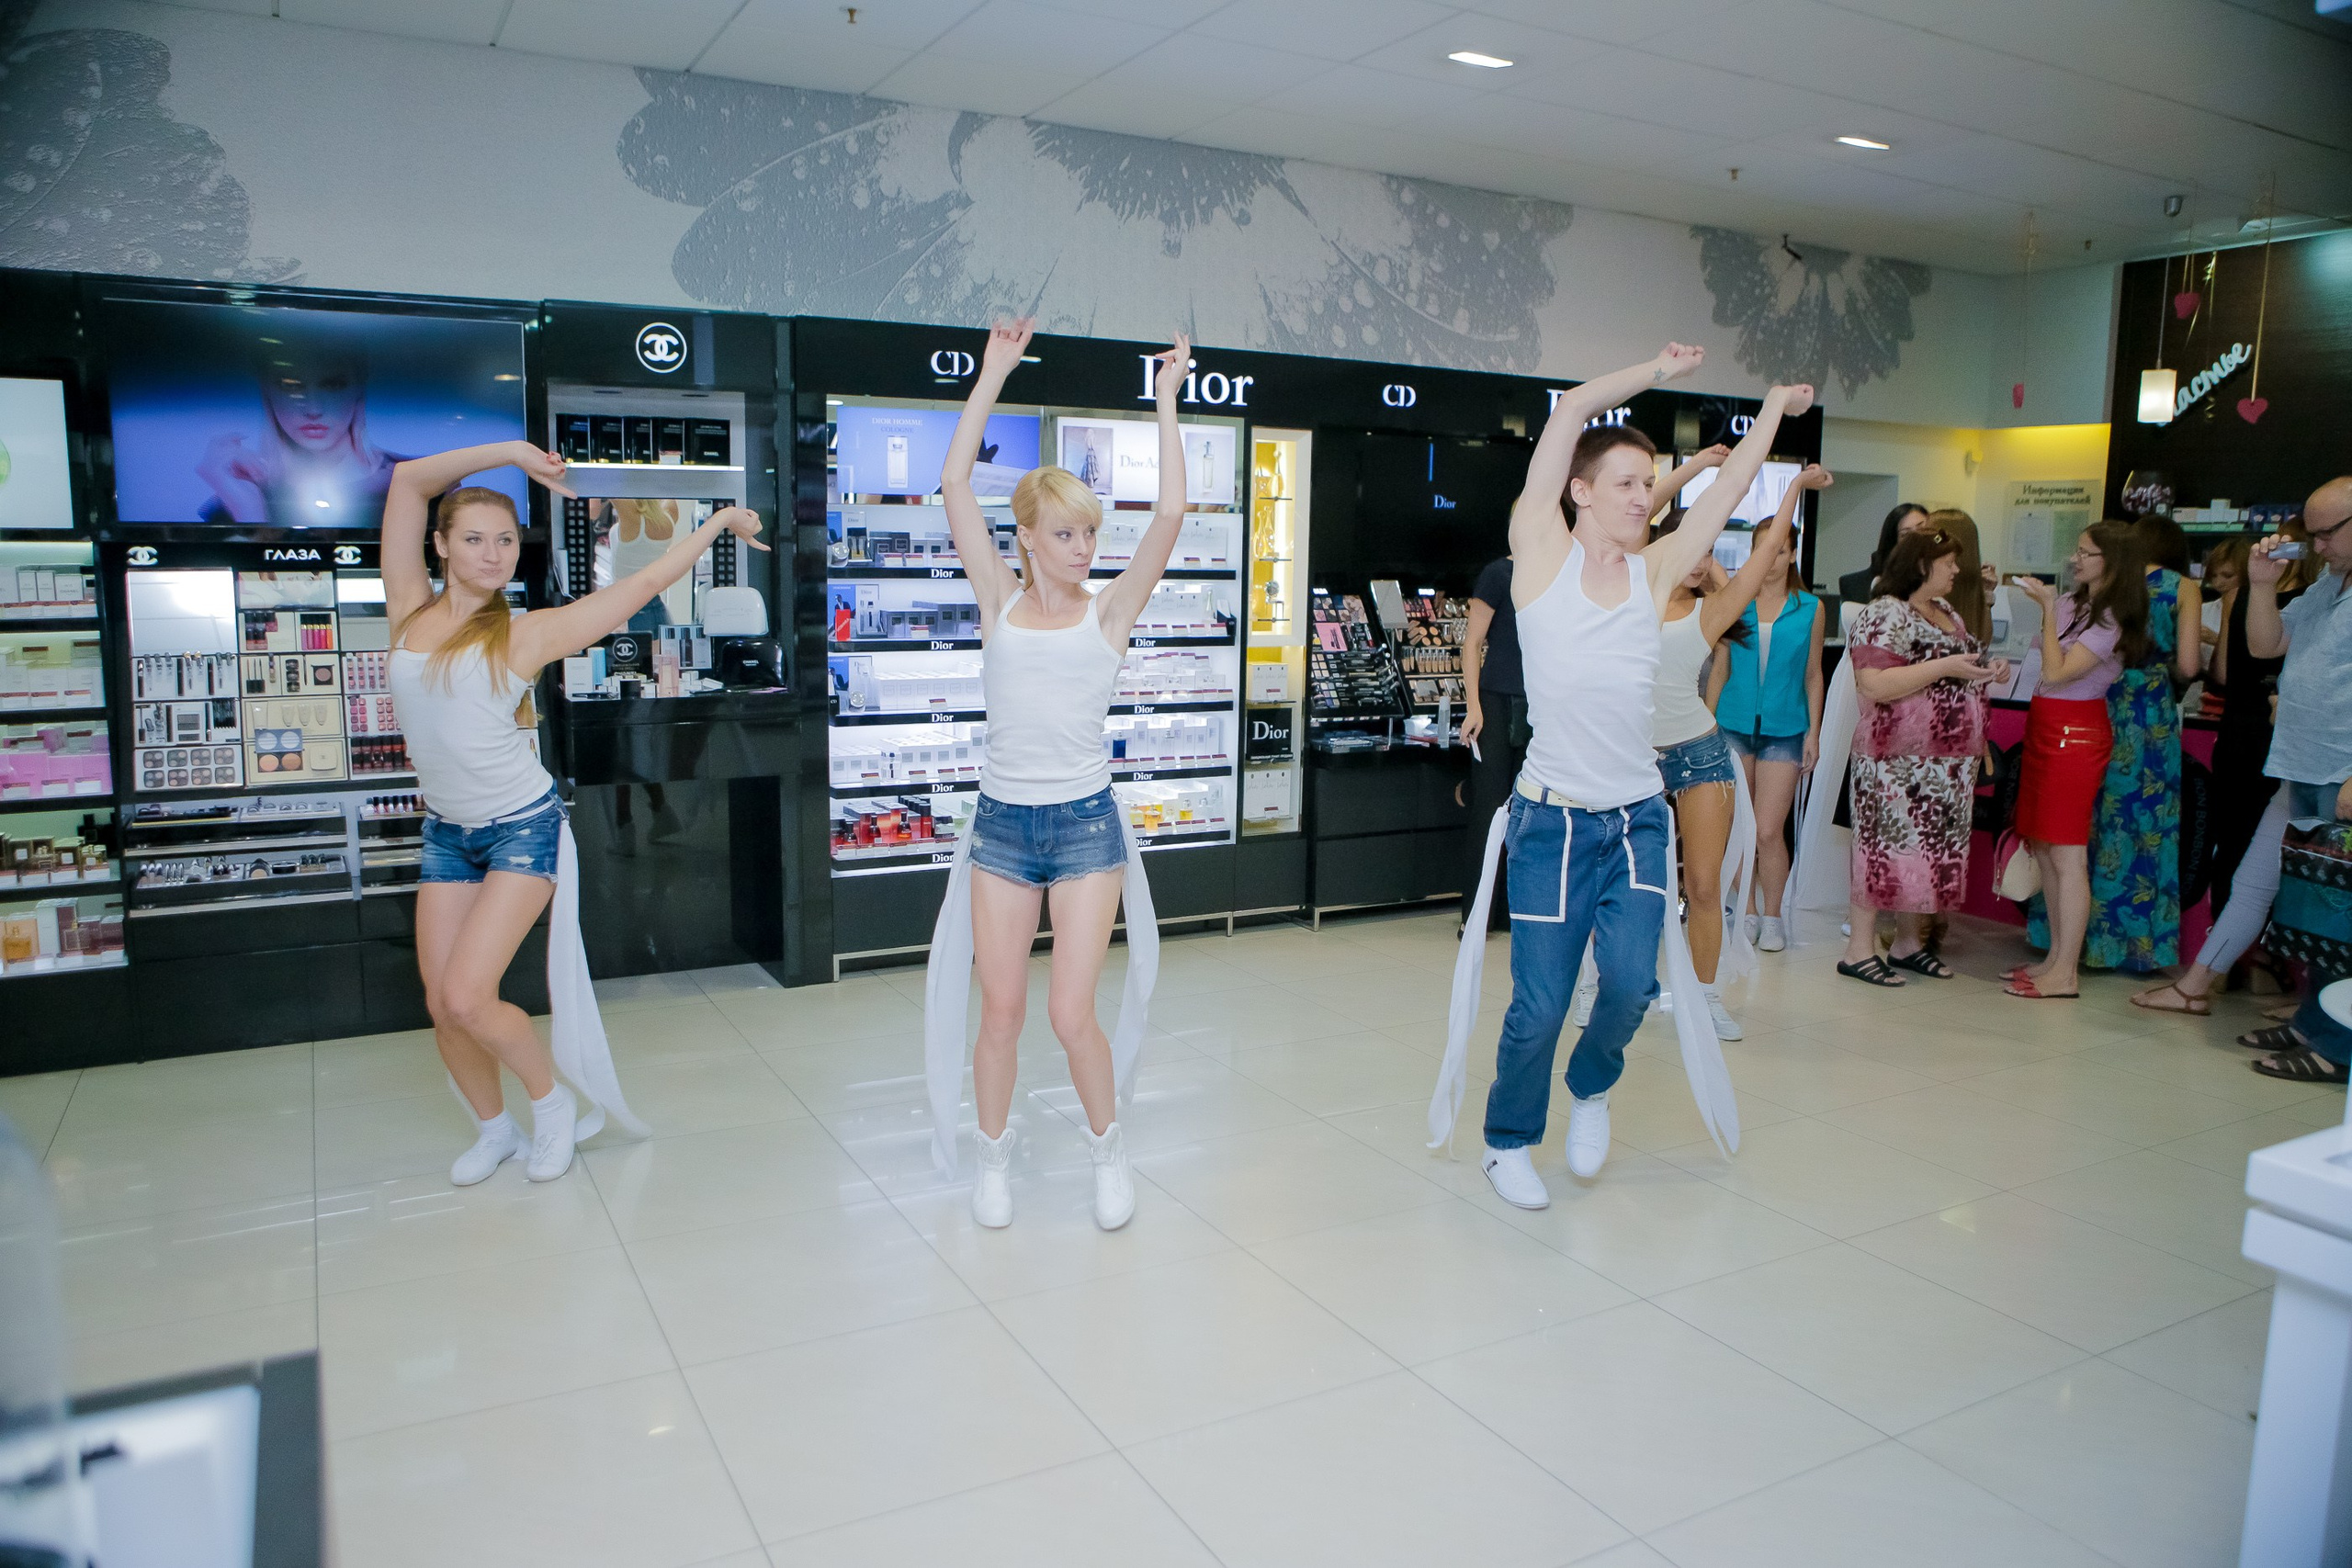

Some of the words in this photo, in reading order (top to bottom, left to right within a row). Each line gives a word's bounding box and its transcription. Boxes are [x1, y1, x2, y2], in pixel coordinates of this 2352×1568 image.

[893, 418, 923, 426] HOMME
[1120, 455, 1144, 468] Dior
[1434, 494, 1456, 509] Dior
[264, 548, 322, 560] ГЛАЗА
[931, 569, 954, 579] Dior
[931, 640, 954, 650] Dior
[1135, 638, 1156, 648] Dior
[1135, 705, 1154, 715] Dior
[932, 713, 954, 723] Dior
[1252, 721, 1289, 740] Dior
[1133, 773, 1153, 782] Dior
[932, 784, 954, 794] Dior
[932, 853, 954, 863] Dior
